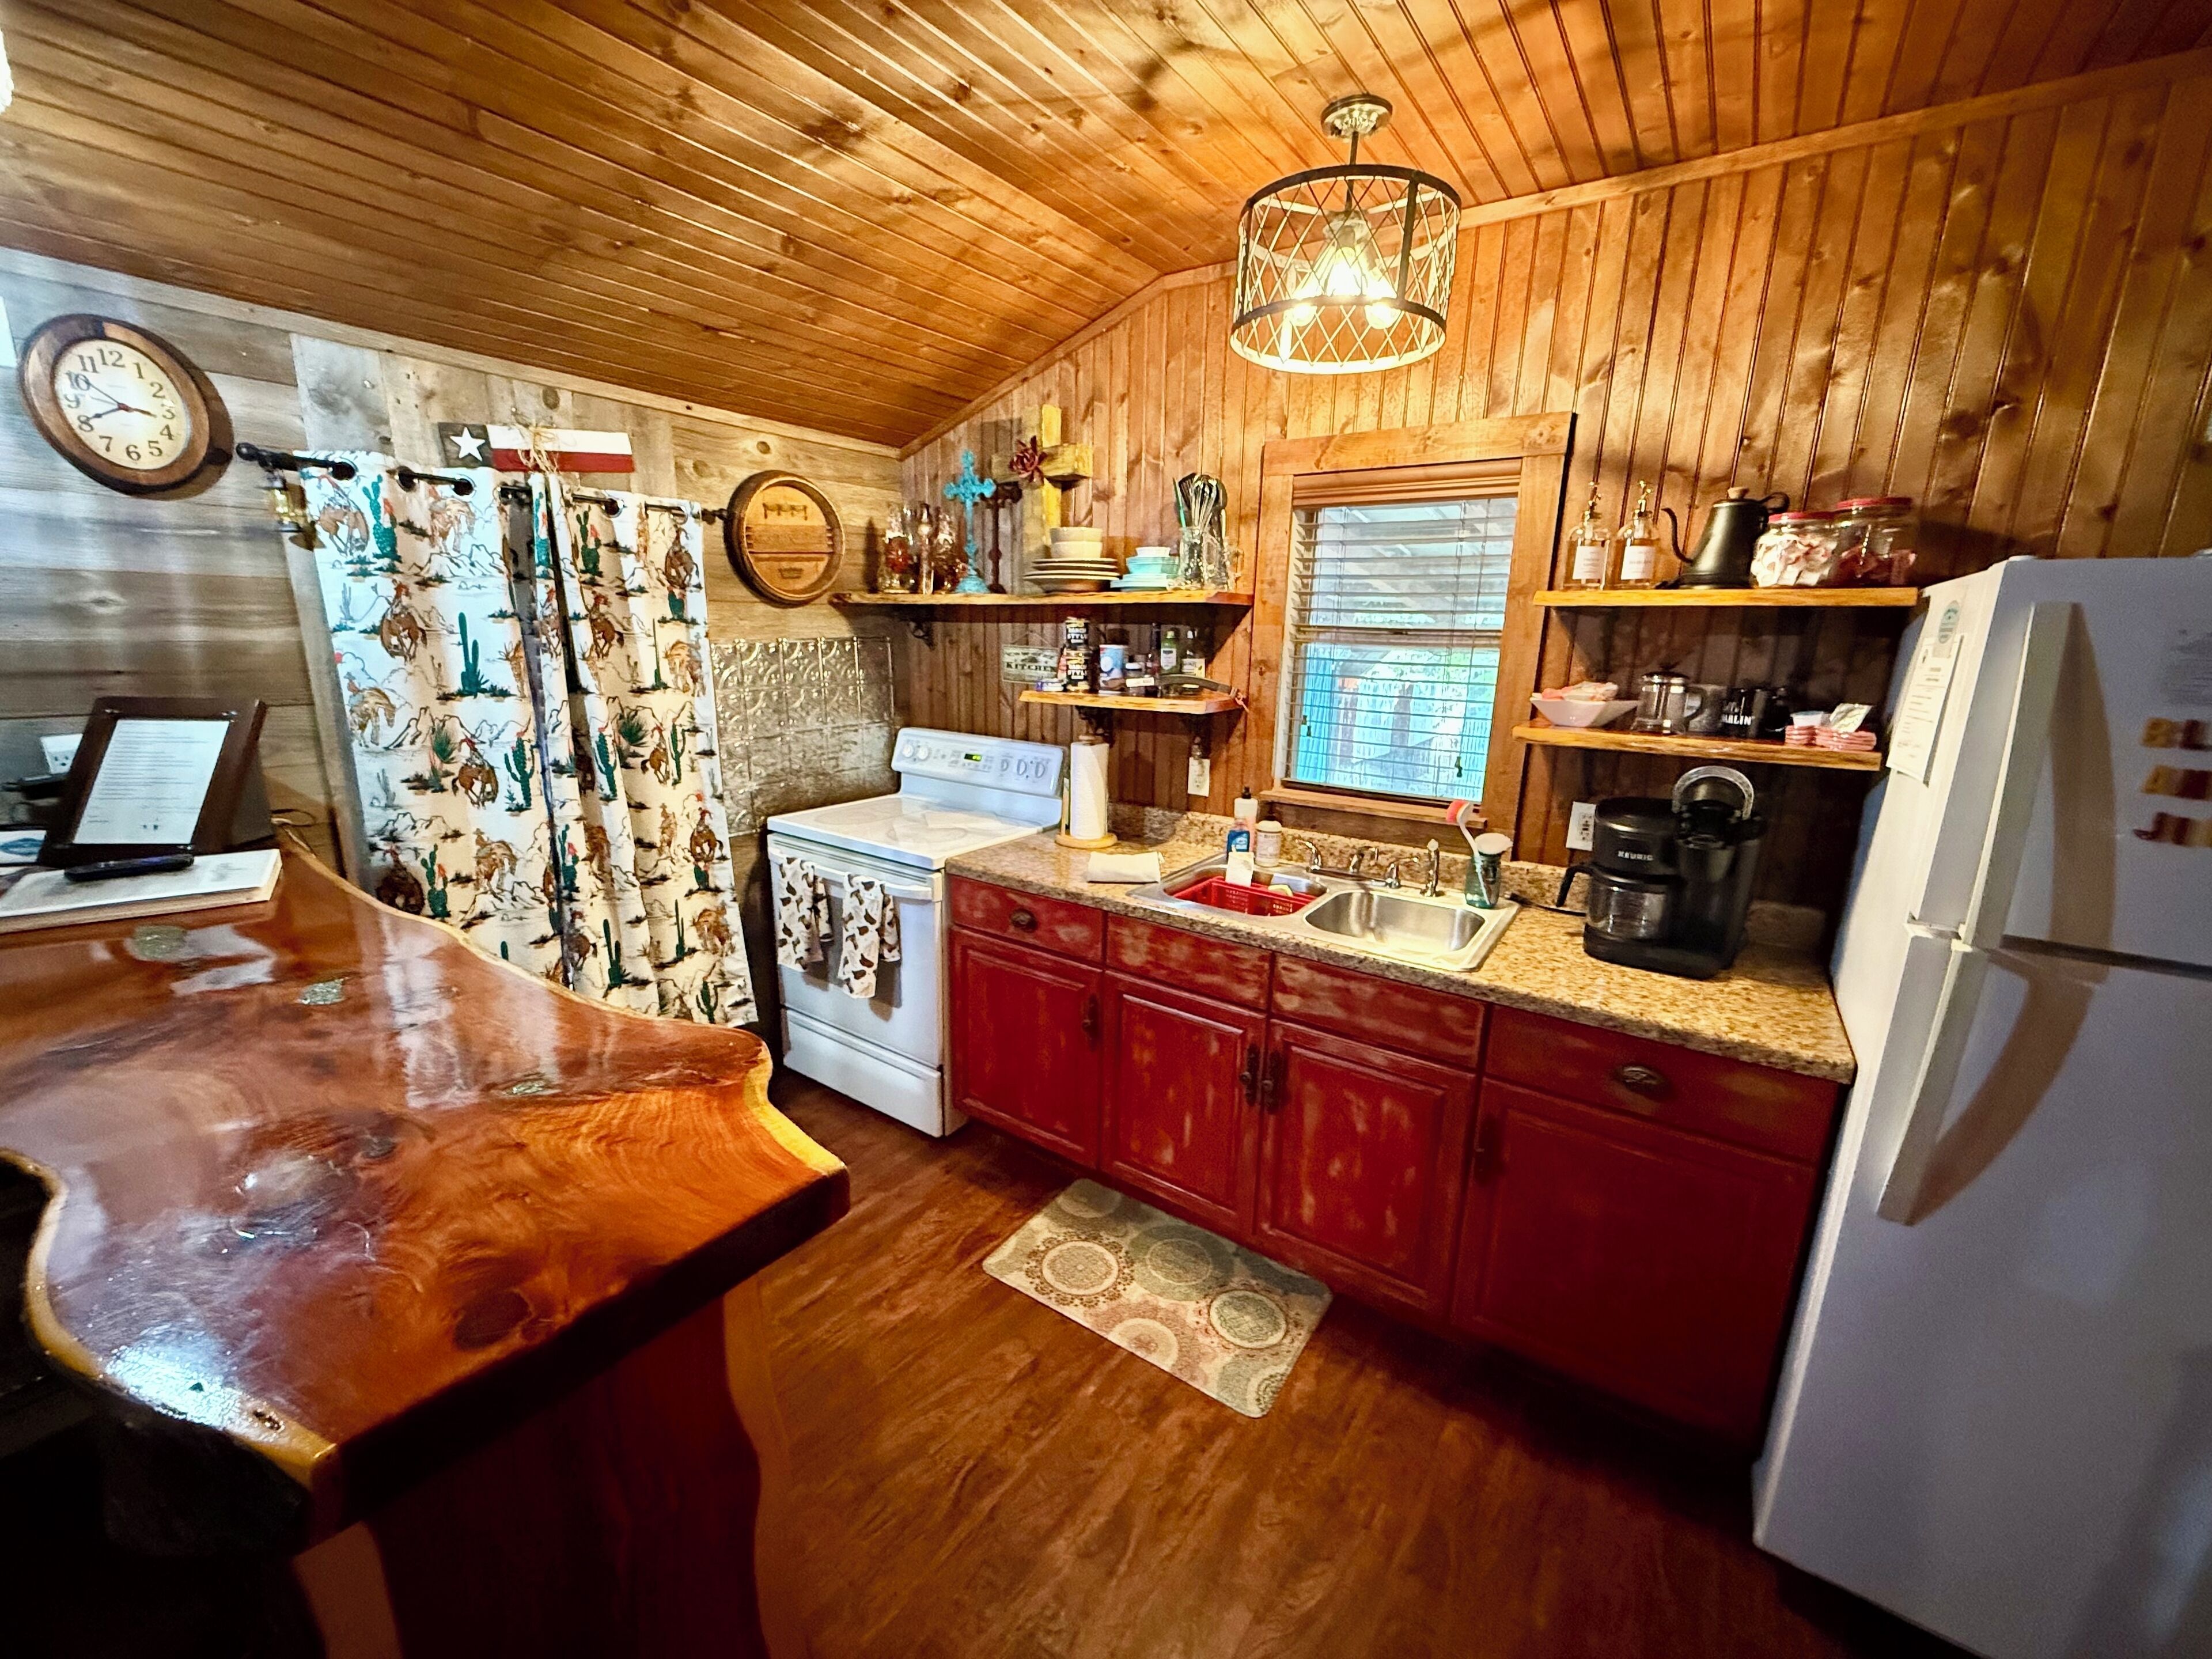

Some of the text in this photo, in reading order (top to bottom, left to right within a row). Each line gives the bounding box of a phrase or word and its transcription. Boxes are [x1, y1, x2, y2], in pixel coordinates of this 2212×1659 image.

[78, 354, 99, 373] 11
[97, 348, 126, 368] 12
[133, 362, 145, 379] 1
[65, 370, 92, 392] 10
[150, 381, 166, 399] 2
[65, 393, 81, 408] 9
[77, 415, 94, 432] 8
[160, 424, 174, 441] 4
[99, 435, 114, 452] 7
[147, 440, 163, 457] 5
[126, 444, 142, 461] 6
